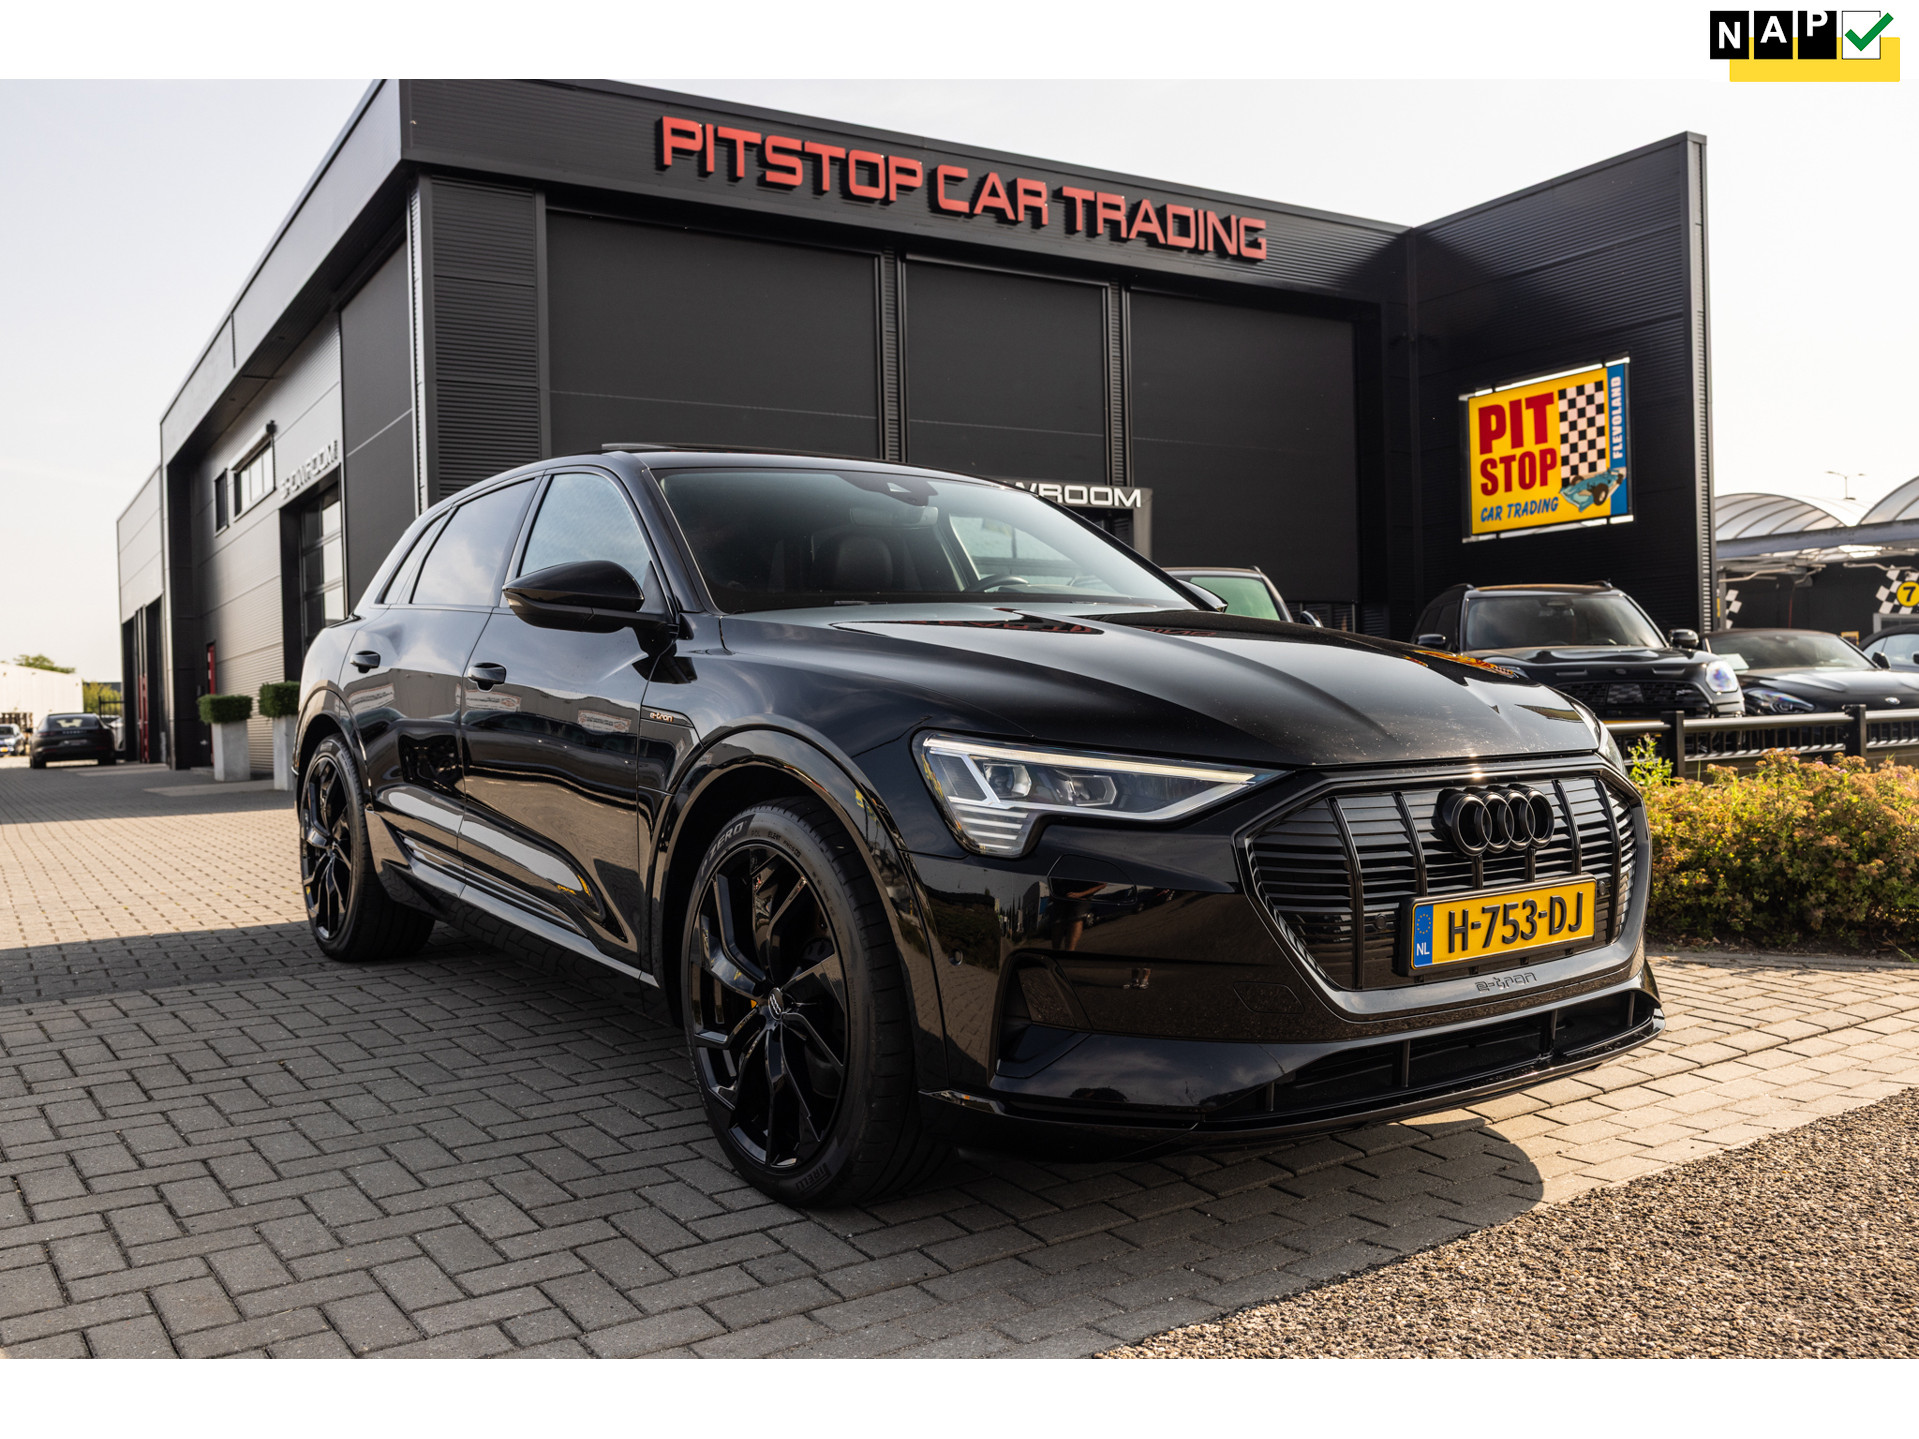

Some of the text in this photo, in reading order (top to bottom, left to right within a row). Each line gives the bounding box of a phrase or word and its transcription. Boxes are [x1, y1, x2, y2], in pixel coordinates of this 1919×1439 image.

[661, 115, 1267, 261] PITSTOP CAR TRADING
[1478, 391, 1555, 455] PIT
[1610, 376, 1623, 459] FLEVOLAND
[1480, 447, 1558, 497] STOP
[1480, 496, 1559, 523] CAR TRADING
[1902, 586, 1916, 602] 7
[649, 711, 674, 723] e-tron
[1416, 891, 1584, 956] NL H-753-DJ
[1474, 971, 1538, 994] e-tron
